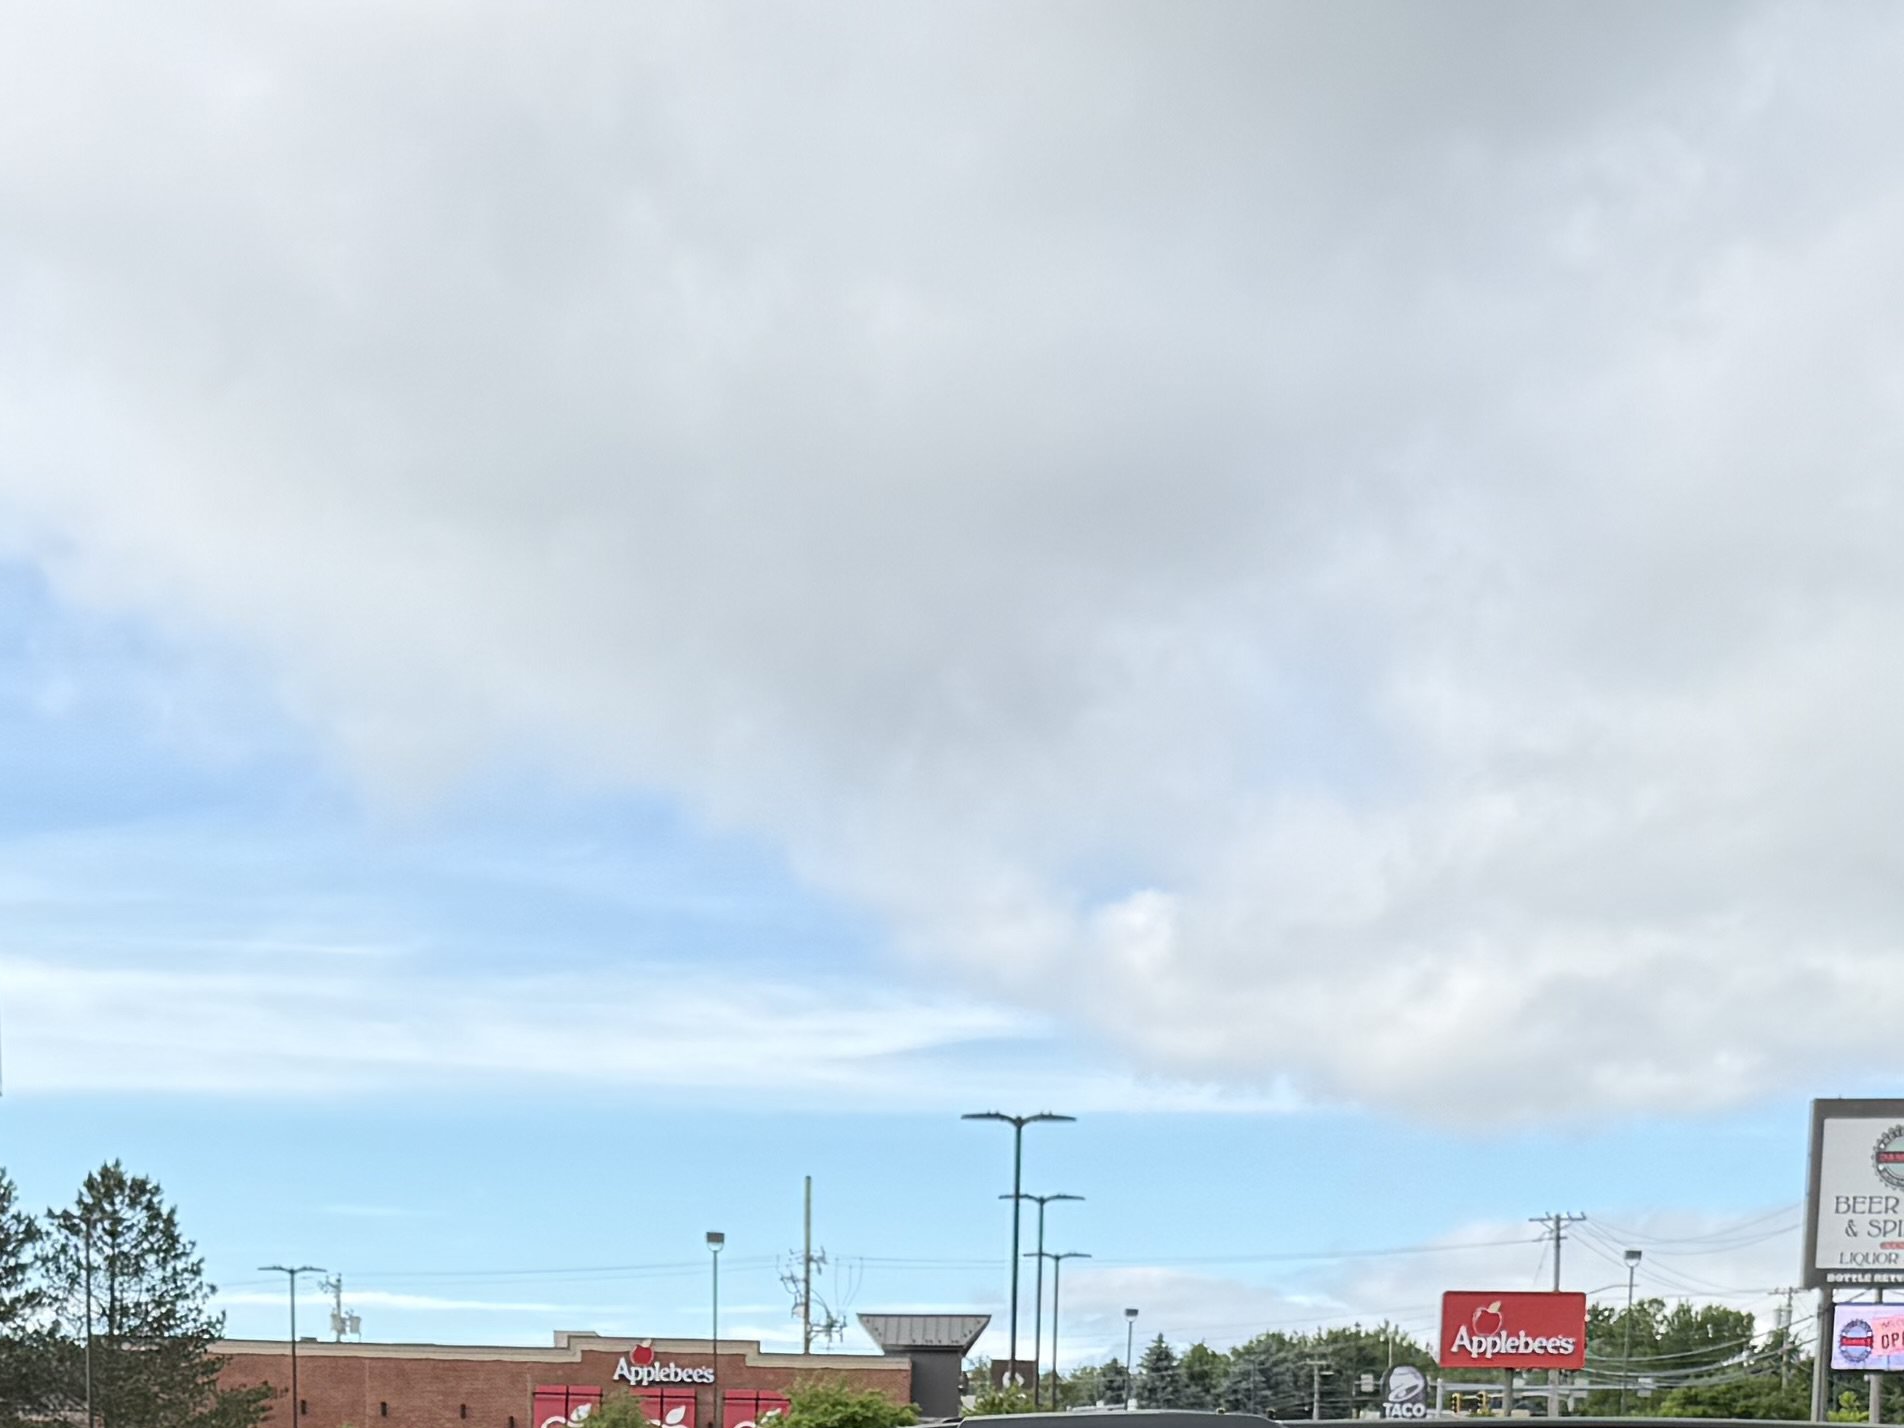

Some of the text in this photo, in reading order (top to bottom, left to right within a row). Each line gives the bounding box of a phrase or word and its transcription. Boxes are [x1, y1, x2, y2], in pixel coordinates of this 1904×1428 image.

[1834, 1195, 1900, 1214] BEER
[1845, 1219, 1858, 1238] &
[1839, 1252, 1898, 1267] LIQUOR
[1827, 1273, 1871, 1284] BOTTLE
[1450, 1324, 1576, 1359] Applebee's
[613, 1357, 715, 1386] Applebee's
[1383, 1403, 1426, 1419] TACO
